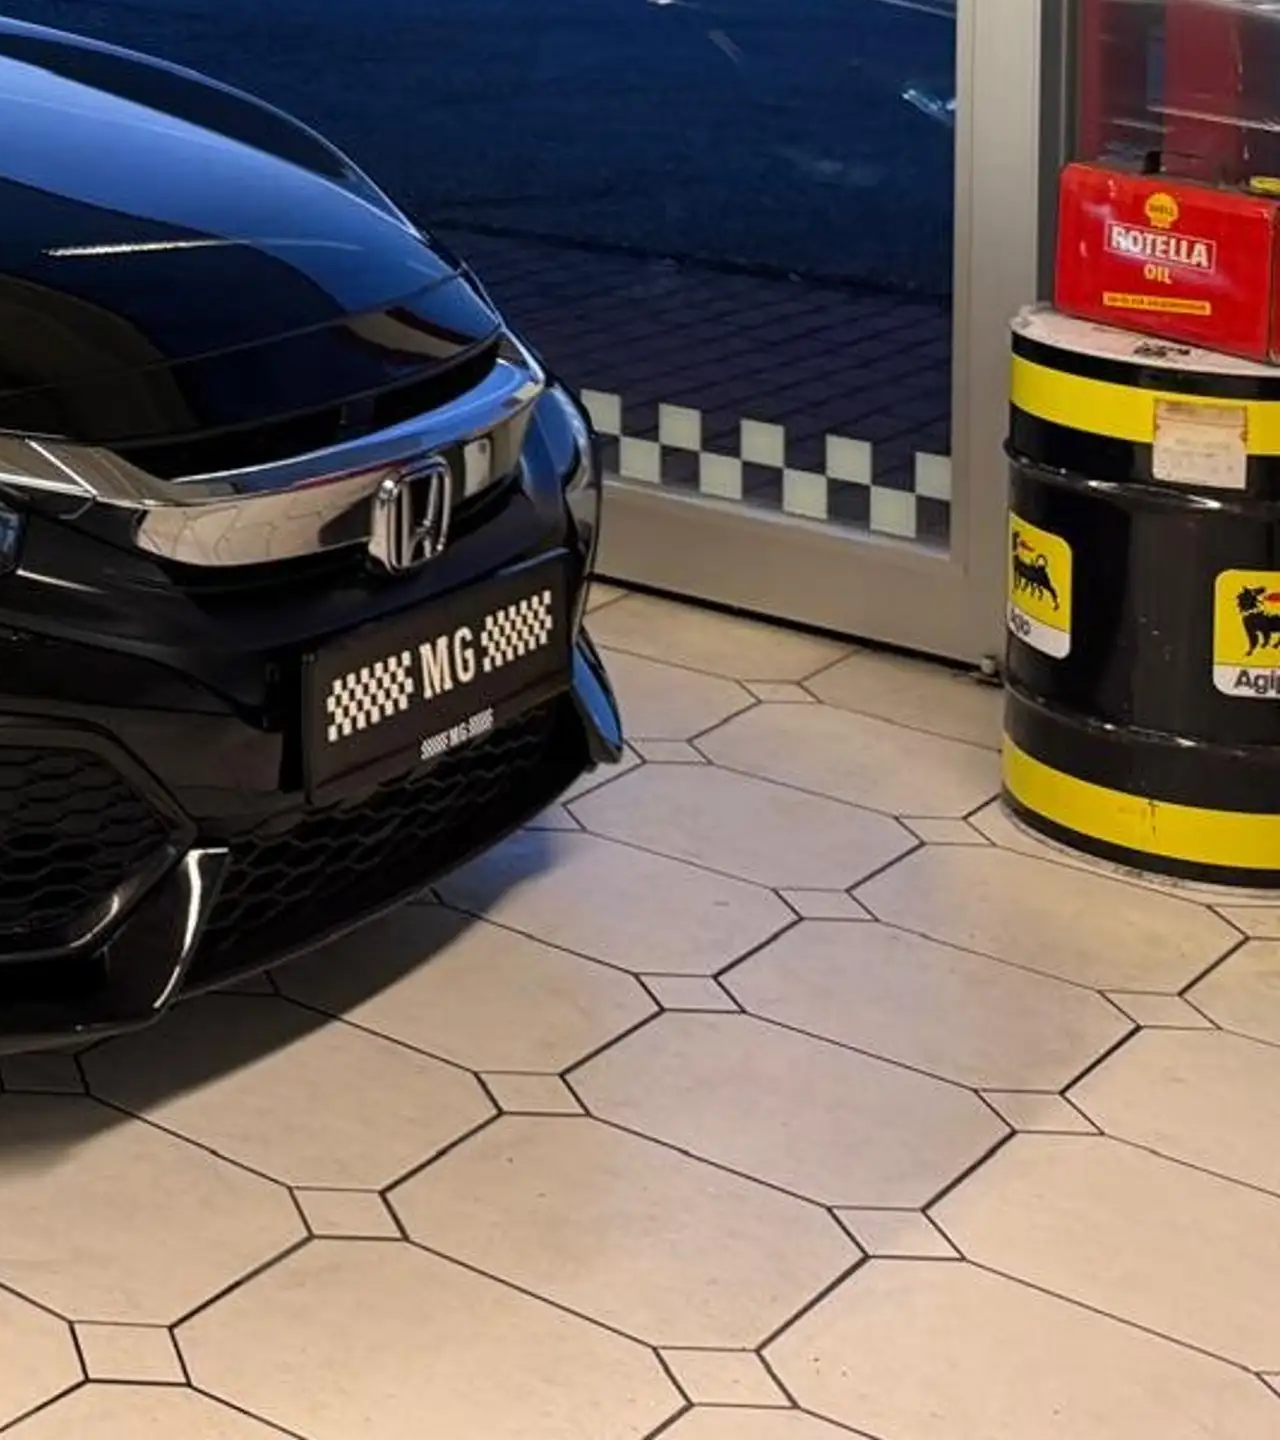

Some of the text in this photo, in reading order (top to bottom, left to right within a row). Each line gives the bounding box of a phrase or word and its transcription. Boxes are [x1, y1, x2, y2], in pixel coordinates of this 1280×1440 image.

[1111, 224, 1210, 268] ROTELLA
[1143, 263, 1173, 285] OIL
[419, 625, 476, 699] MG
[448, 722, 468, 748] MG
